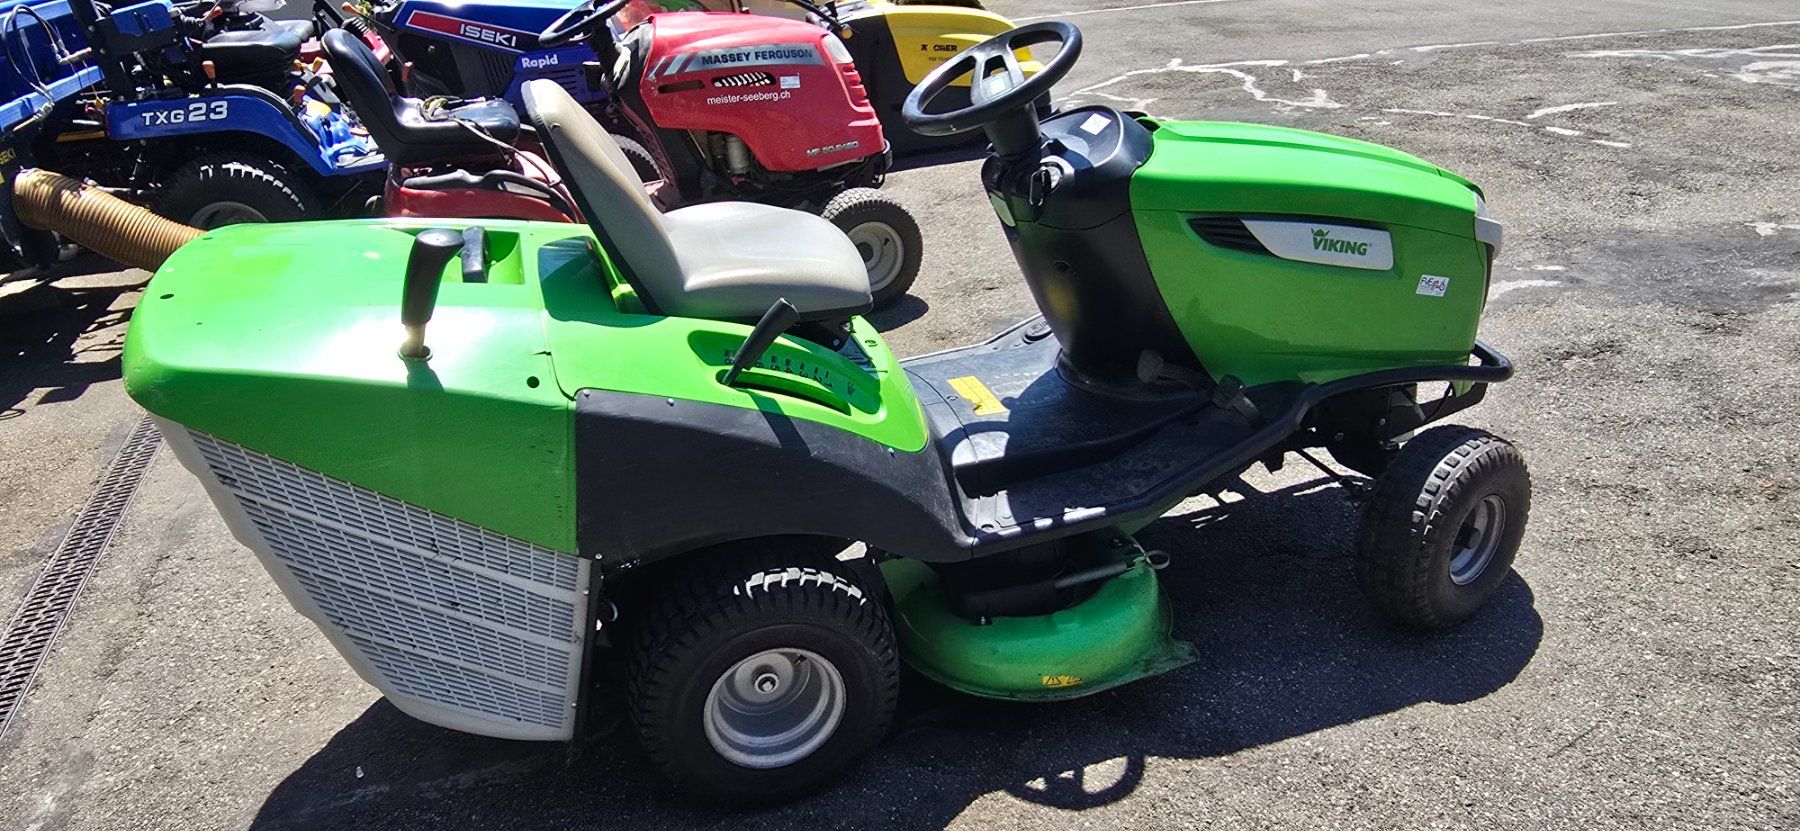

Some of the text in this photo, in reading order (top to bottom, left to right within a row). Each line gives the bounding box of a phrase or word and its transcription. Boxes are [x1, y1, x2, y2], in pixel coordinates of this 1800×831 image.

[459, 23, 517, 47] ISEKI
[521, 54, 559, 69] Rapid
[701, 49, 813, 65] MASSEY FERGUSON
[706, 90, 791, 105] meister-seeberg.ch
[1312, 237, 1368, 256] VIKING
